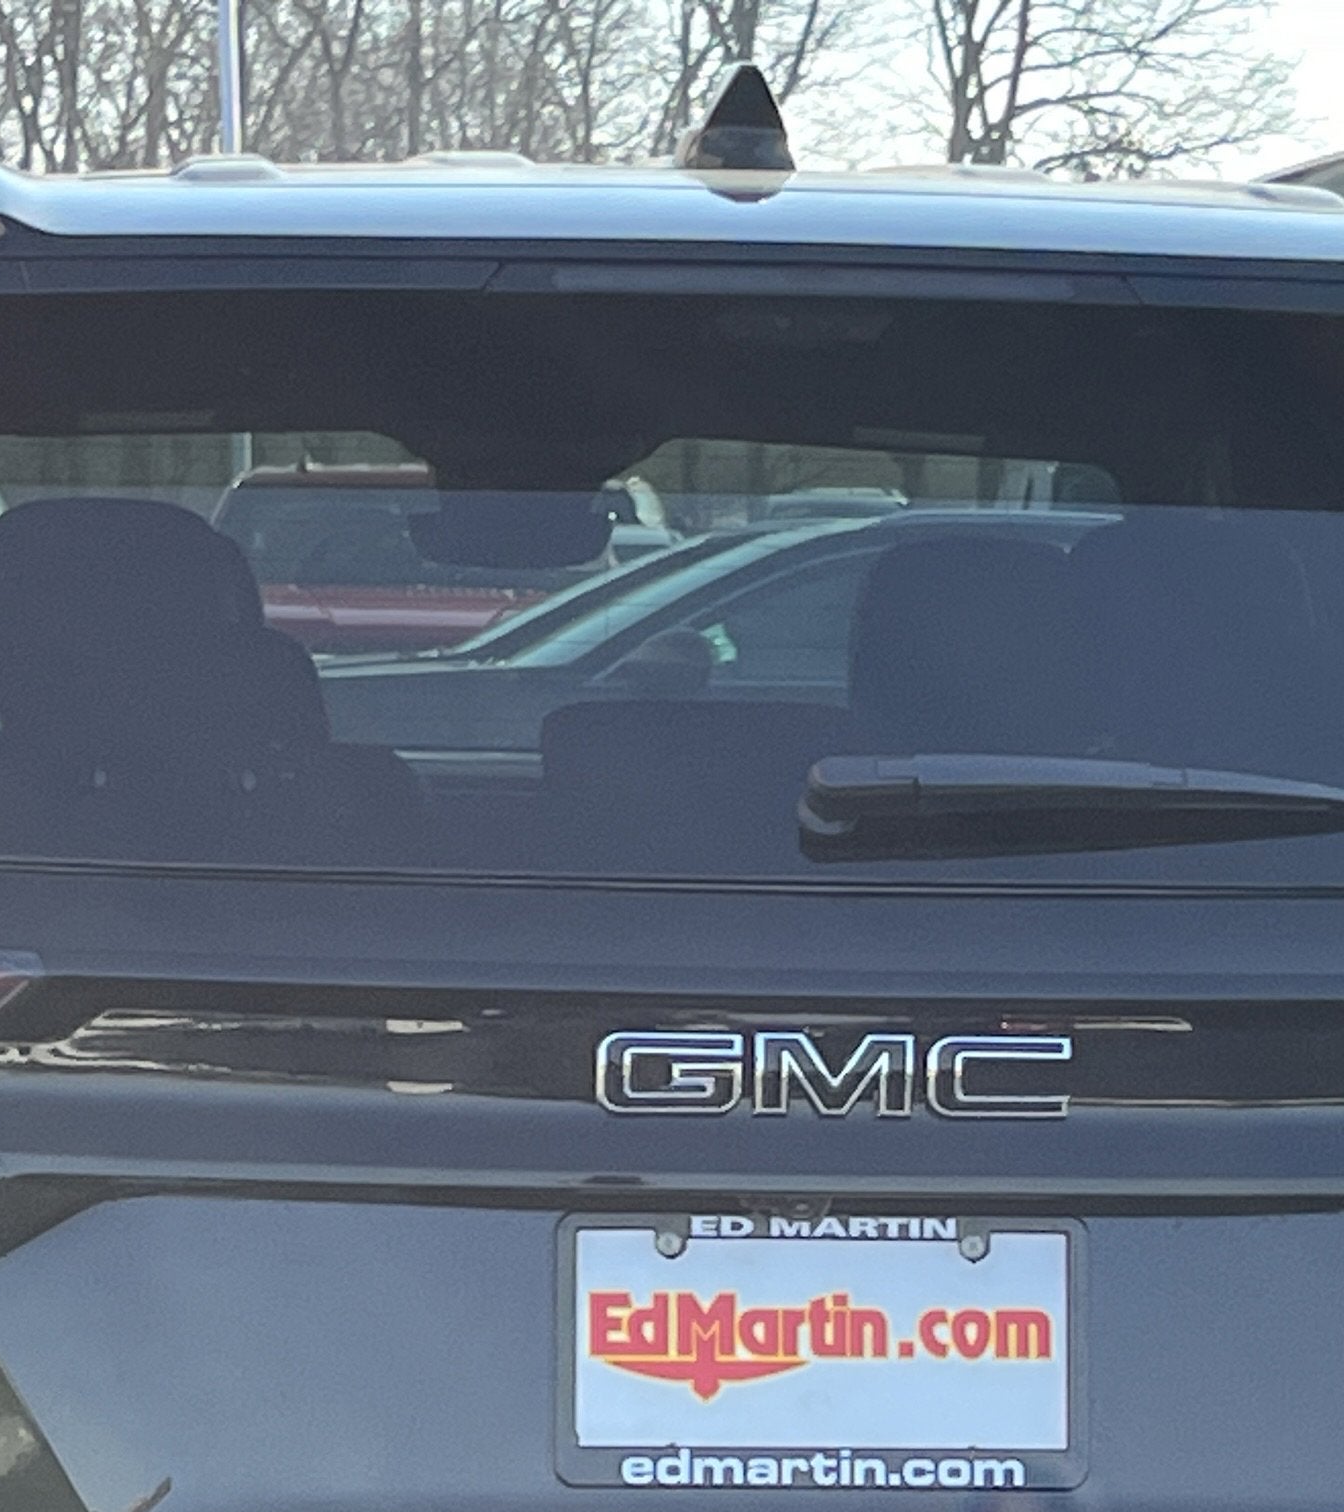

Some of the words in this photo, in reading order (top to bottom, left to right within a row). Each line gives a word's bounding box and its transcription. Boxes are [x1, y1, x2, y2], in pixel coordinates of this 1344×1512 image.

[596, 1031, 1072, 1118] GMC
[690, 1217, 754, 1238] ED
[769, 1217, 957, 1239] MARTIN
[588, 1291, 1053, 1361] EdMartin.com
[621, 1449, 1025, 1488] edmartin.com
